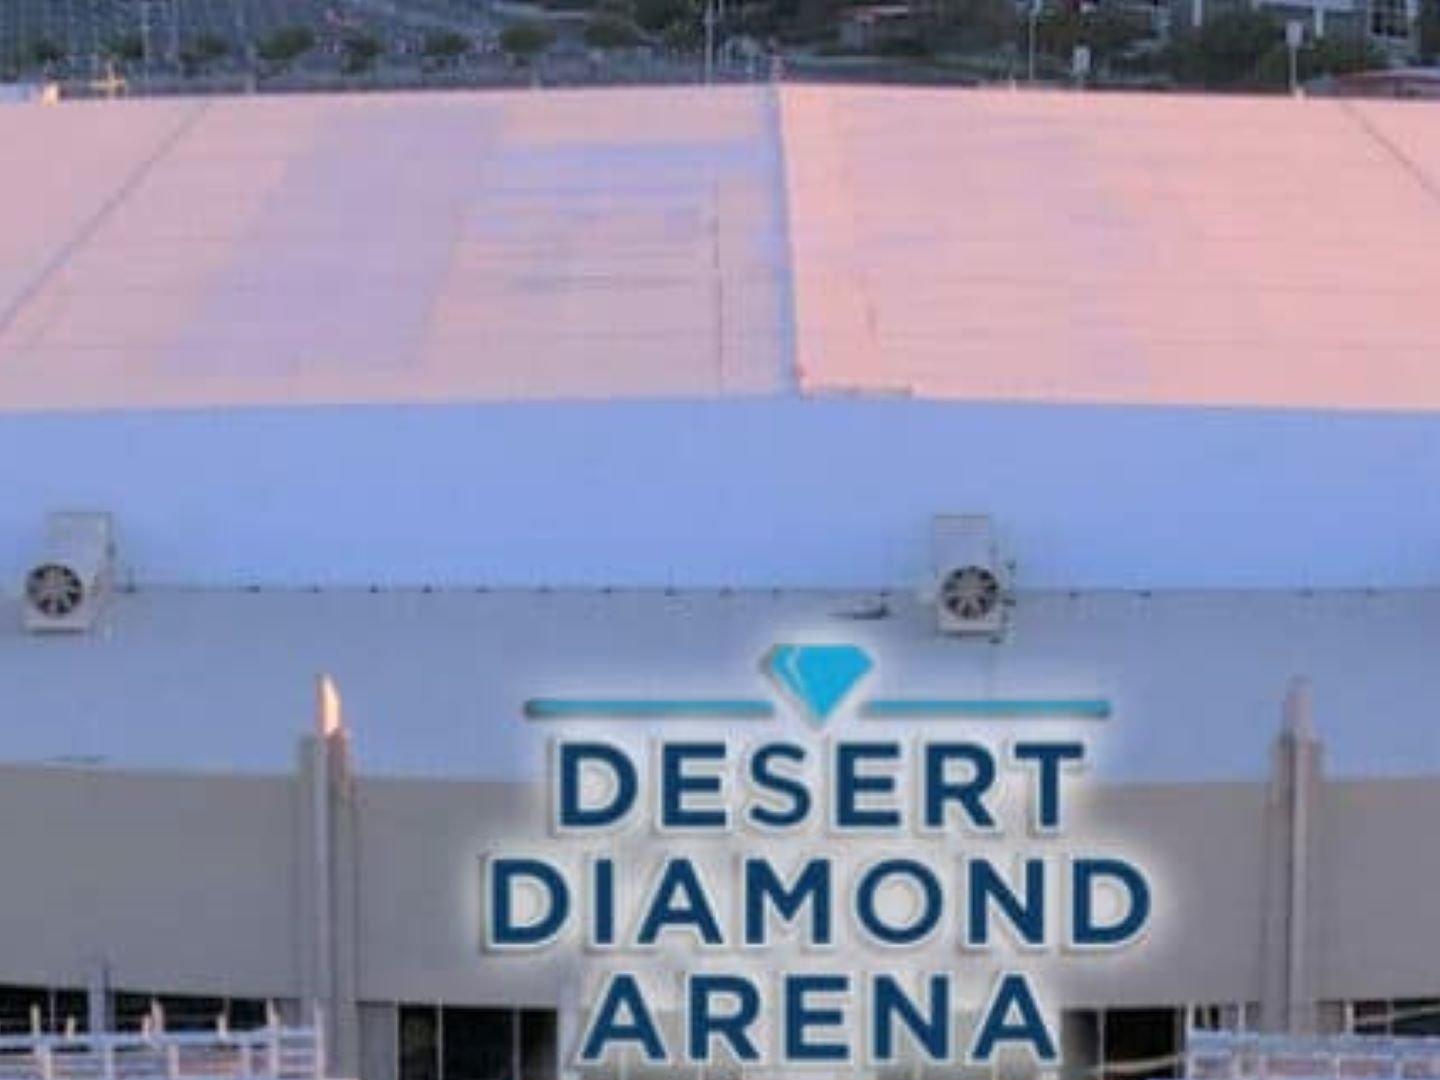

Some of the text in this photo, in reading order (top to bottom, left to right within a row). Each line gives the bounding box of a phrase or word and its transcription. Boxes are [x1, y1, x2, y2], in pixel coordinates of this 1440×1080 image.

[556, 740, 1086, 829] DESERT
[490, 858, 1152, 946] DIAMOND
[581, 973, 1056, 1061] ARENA
